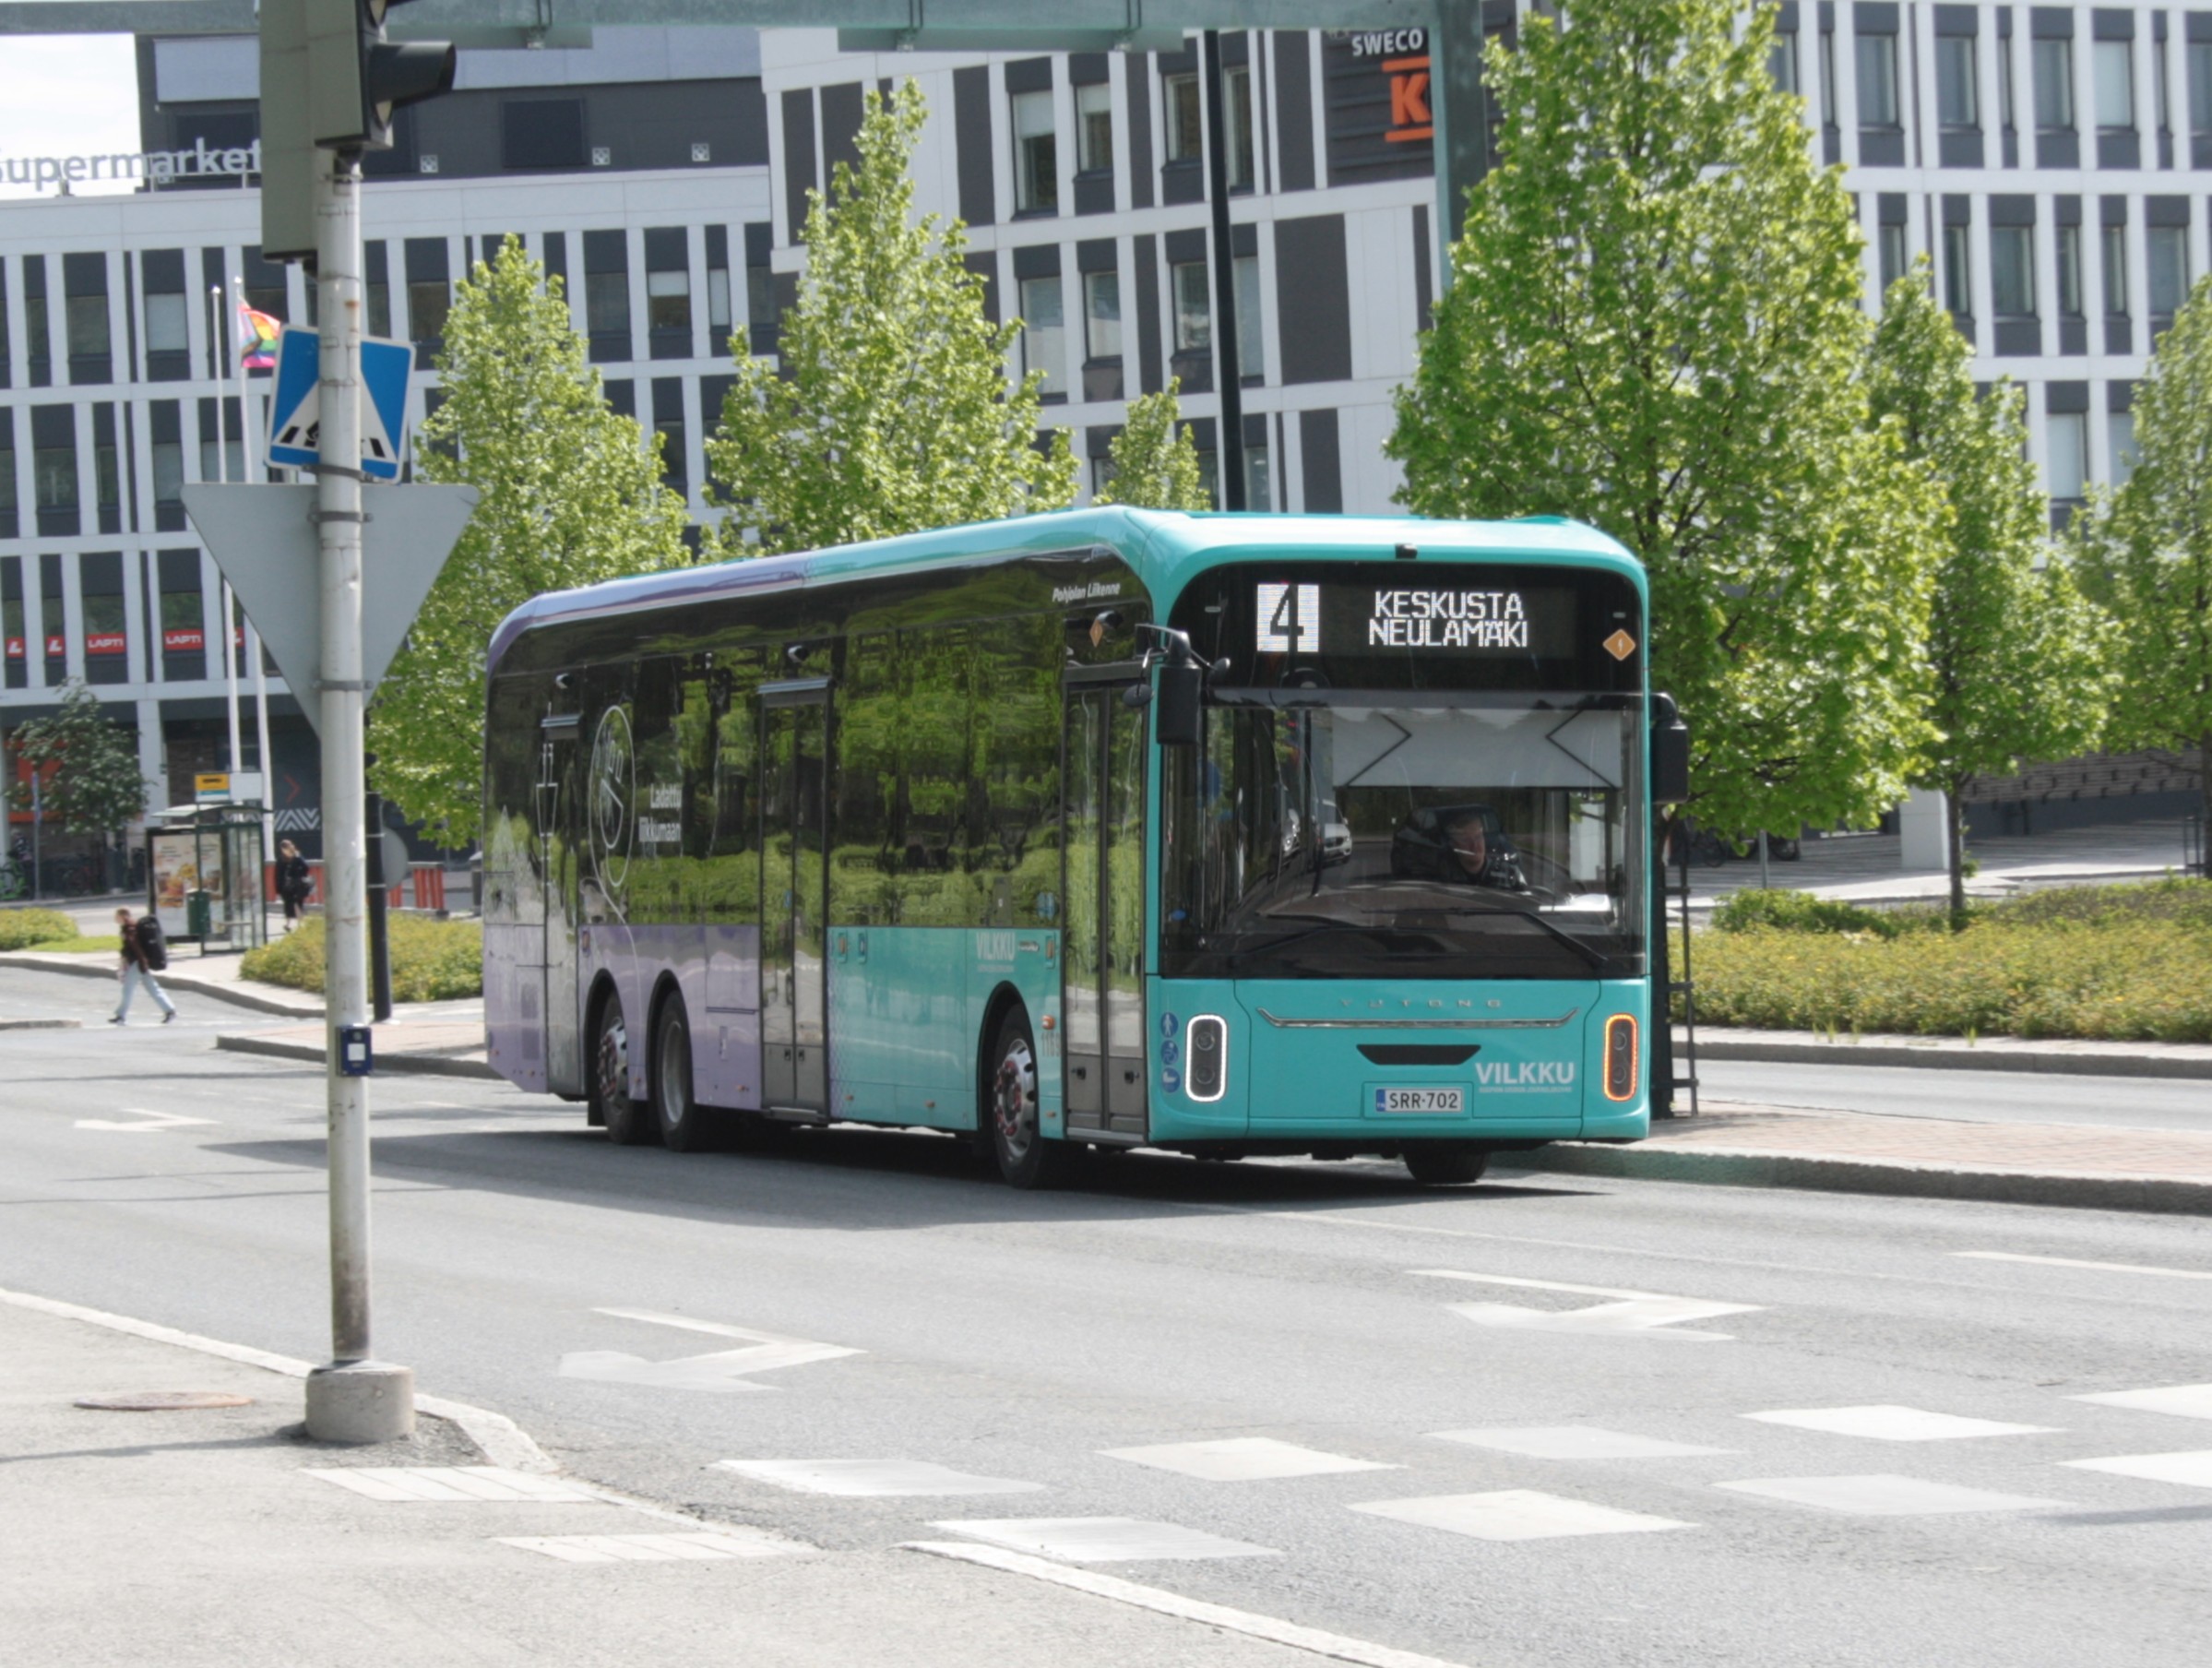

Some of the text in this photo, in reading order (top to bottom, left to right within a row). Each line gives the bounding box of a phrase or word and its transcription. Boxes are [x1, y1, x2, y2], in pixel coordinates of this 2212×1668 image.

[1351, 29, 1423, 56] SWECO
[1390, 72, 1433, 125] K
[0, 137, 262, 192] upermarket
[1269, 584, 1304, 652] 4
[1374, 591, 1524, 619] KESKUSTA
[88, 637, 124, 649] LAPTI
[165, 635, 202, 645] LAPTI
[1369, 618, 1528, 648] NEULAMÄKI
[976, 931, 1016, 961] VILKKU
[1340, 998, 1502, 1009] YUTONG
[1476, 1062, 1575, 1085] VILKKU
[1389, 1092, 1458, 1109] SRR-702
